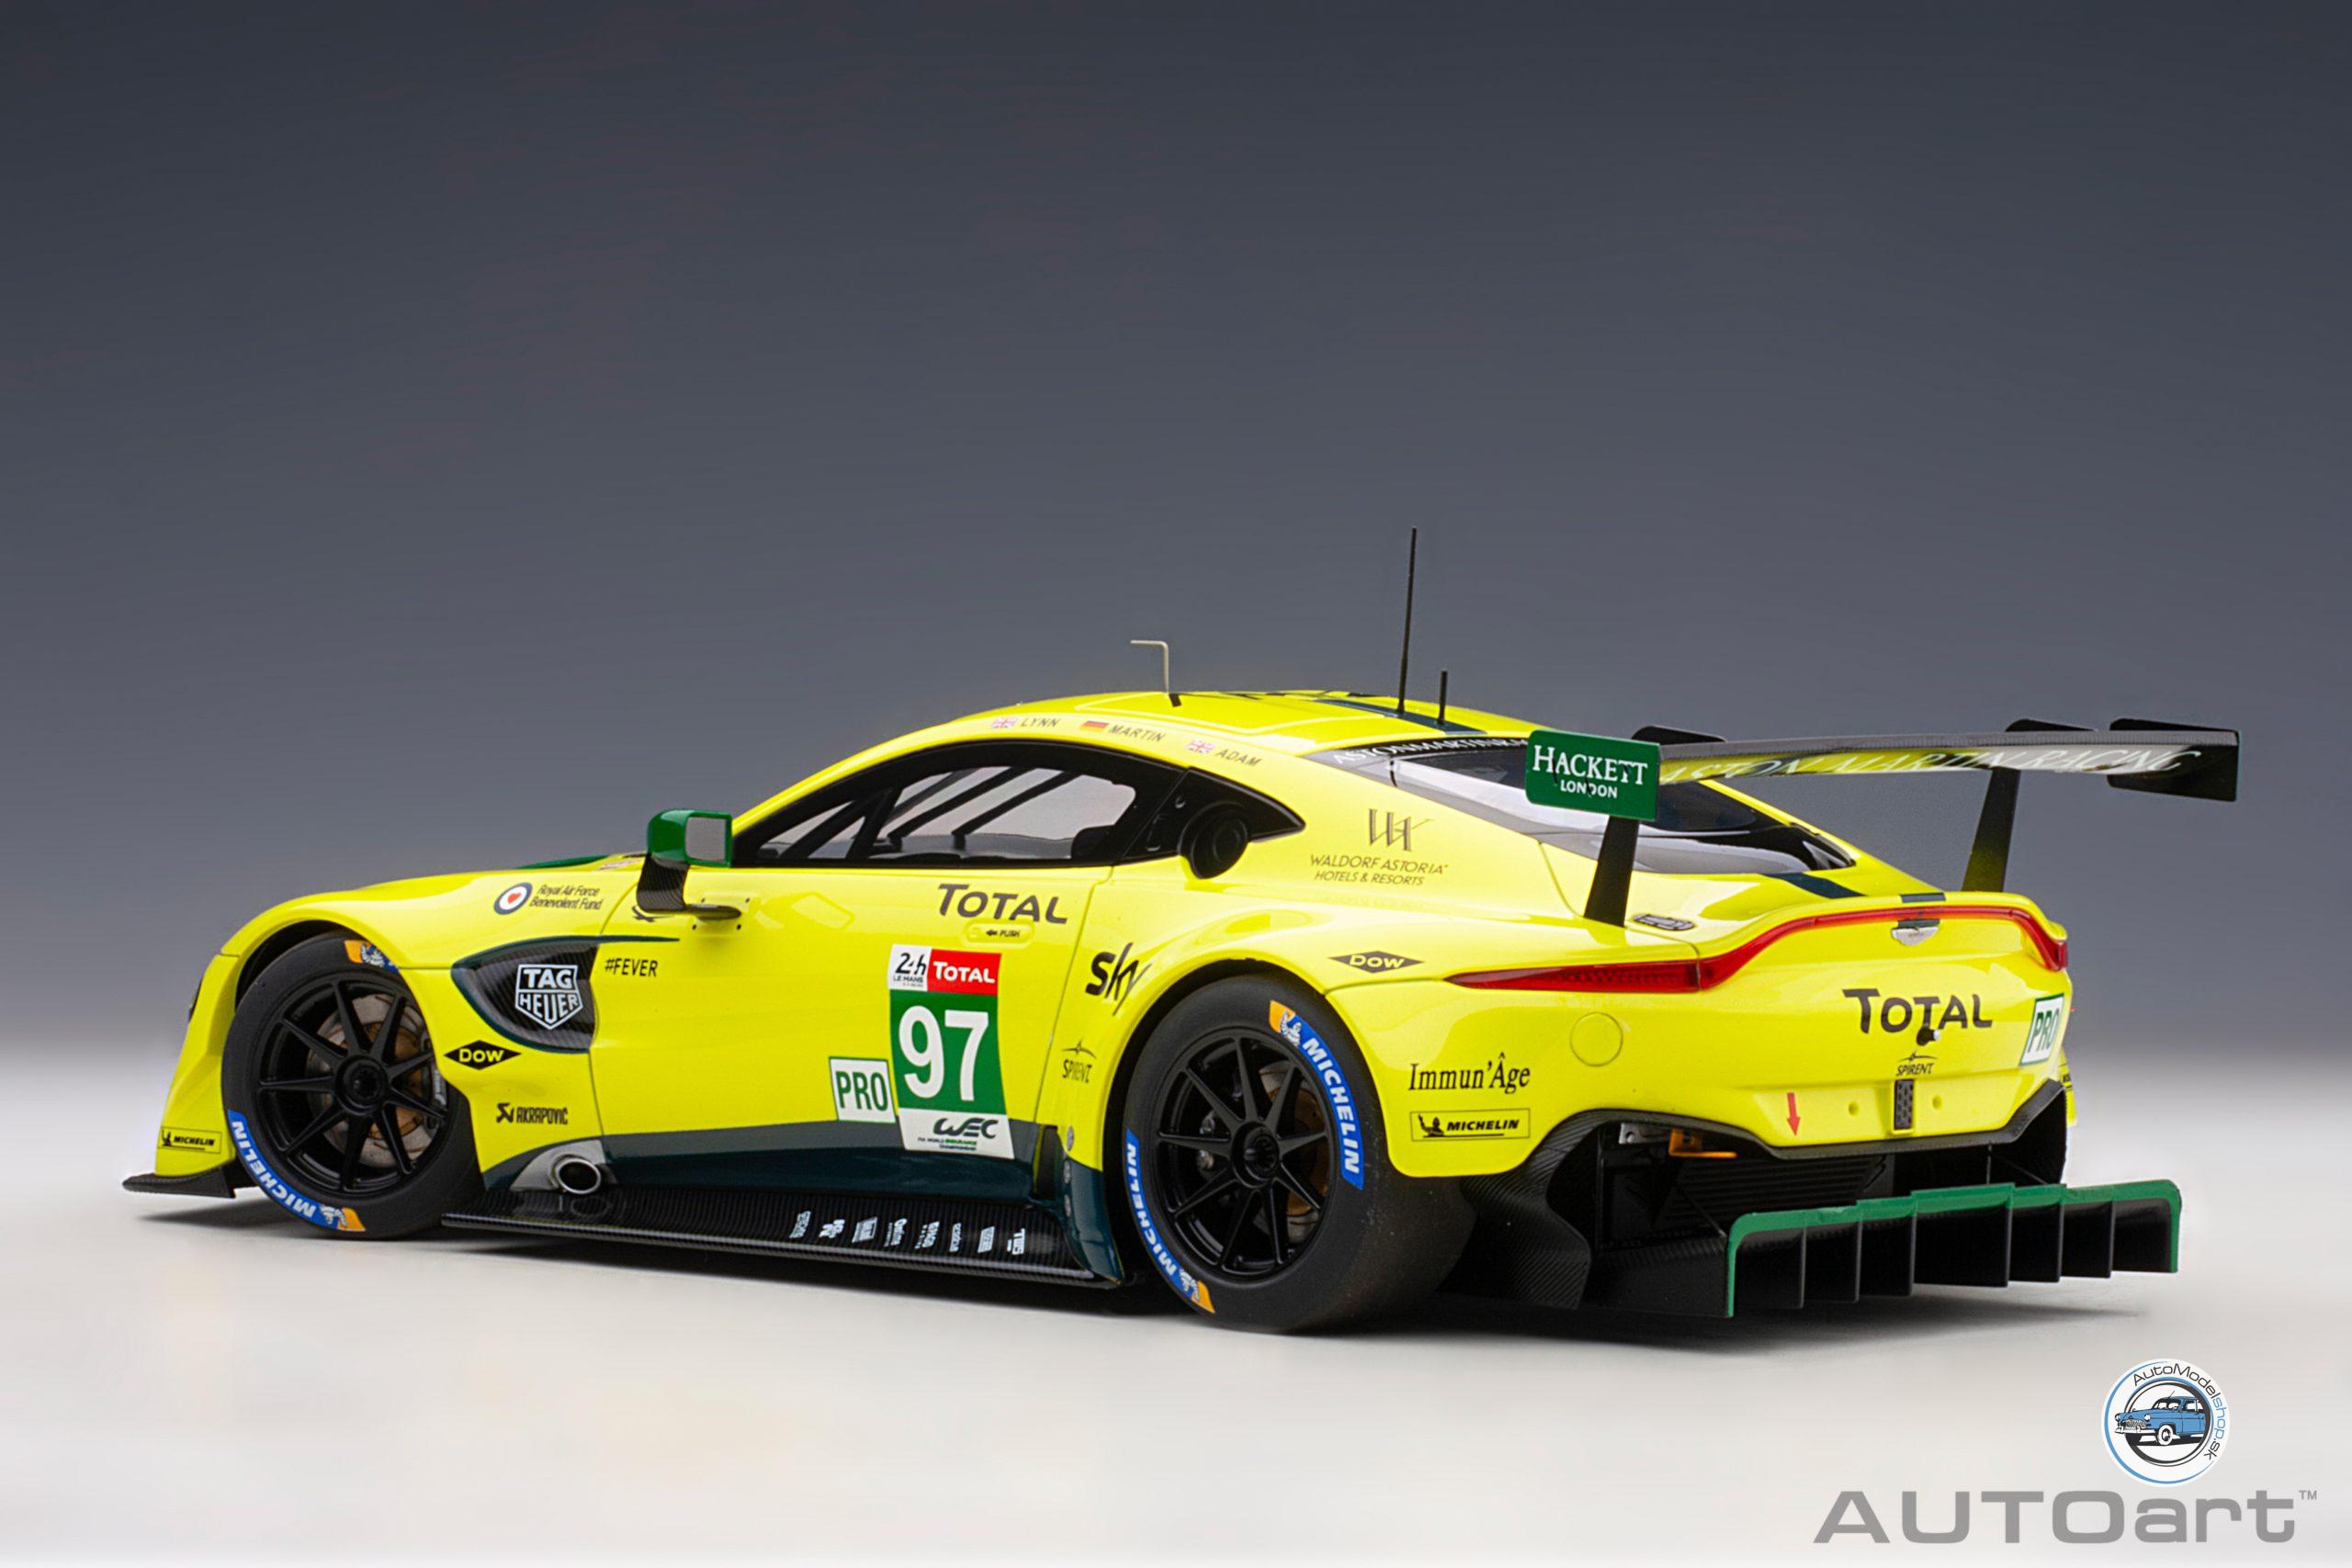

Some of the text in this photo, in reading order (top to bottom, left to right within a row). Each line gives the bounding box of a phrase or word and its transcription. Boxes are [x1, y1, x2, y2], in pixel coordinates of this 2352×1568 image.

[1021, 717, 1061, 728] LYNN
[1108, 724, 1167, 742] MARTIN
[1215, 749, 1263, 767] ADAM
[1532, 745, 1648, 784] HACKETT
[2025, 749, 2202, 772] RACING
[1560, 780, 1618, 798] LONDON
[1310, 854, 1443, 874] WALDORF ASTORIA
[1314, 871, 1425, 886] HOTELS & RESORTS
[537, 884, 600, 897] Royal Air Force
[529, 896, 603, 909] Benevolent Fund
[937, 884, 1069, 924] TOTAL
[604, 957, 659, 977] #FEVER
[933, 961, 995, 984] TOTAL
[524, 969, 572, 989] TAG
[519, 992, 580, 1023] HEUER
[1842, 988, 1993, 1034] TOTAL
[2027, 1009, 2060, 1053] PRO
[899, 1005, 989, 1101] 97
[1895, 1063, 1934, 1077] SPIRENT
[835, 1070, 888, 1111] PRO
[1303, 1037, 1360, 1175] MICHELIN
[933, 1117, 999, 1139] WEC
[1446, 1119, 1520, 1132] MICHELIN
[174, 1135, 215, 1146] MICHELIN
[232, 1121, 317, 1218] MICHELIN
[1127, 1144, 1177, 1277] MICHELIN
